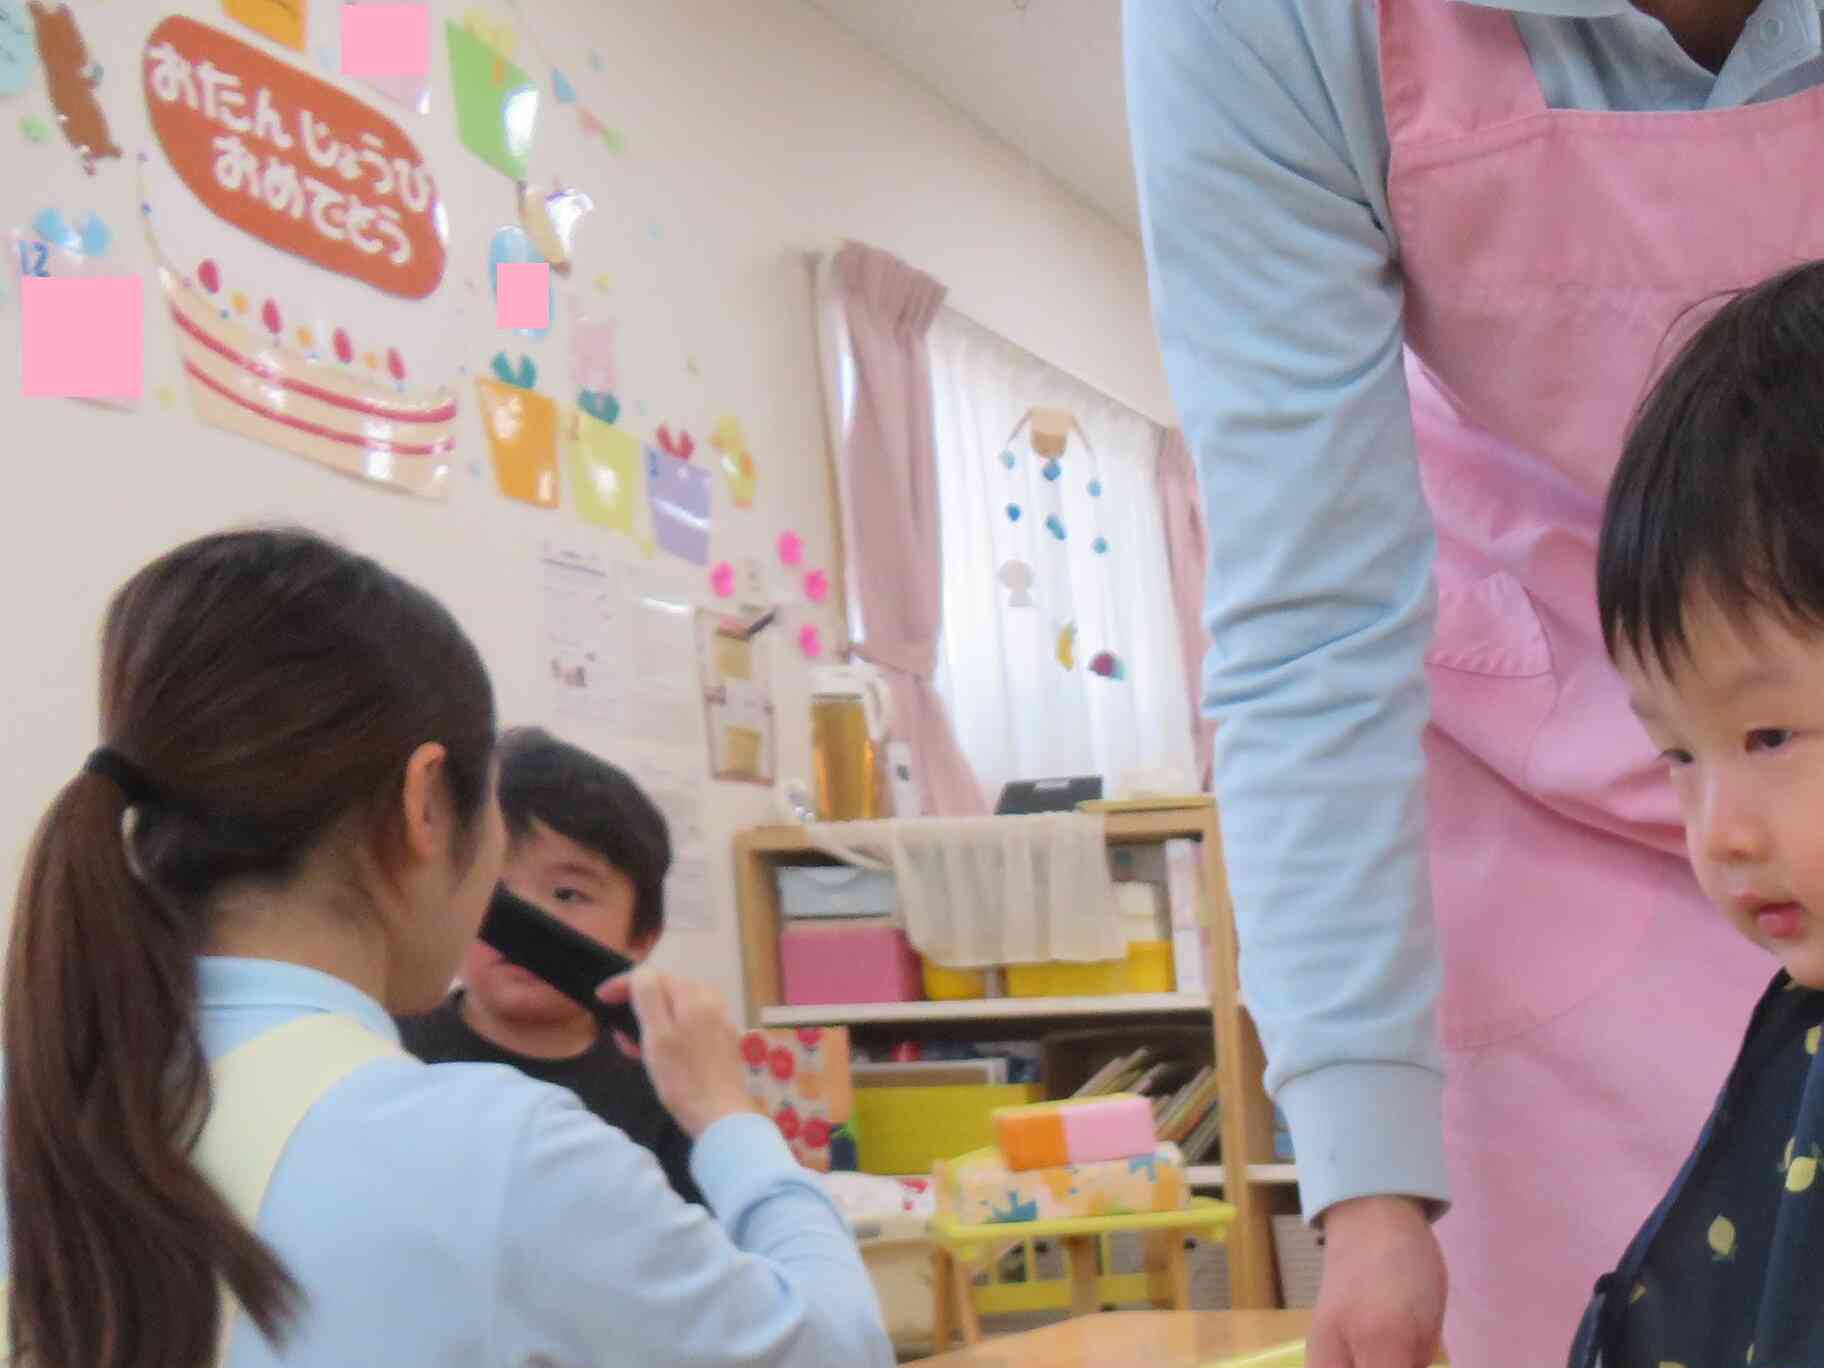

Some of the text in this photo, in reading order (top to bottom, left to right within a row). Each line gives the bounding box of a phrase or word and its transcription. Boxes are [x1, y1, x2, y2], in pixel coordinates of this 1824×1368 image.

[211, 134, 412, 264] おめでとう
